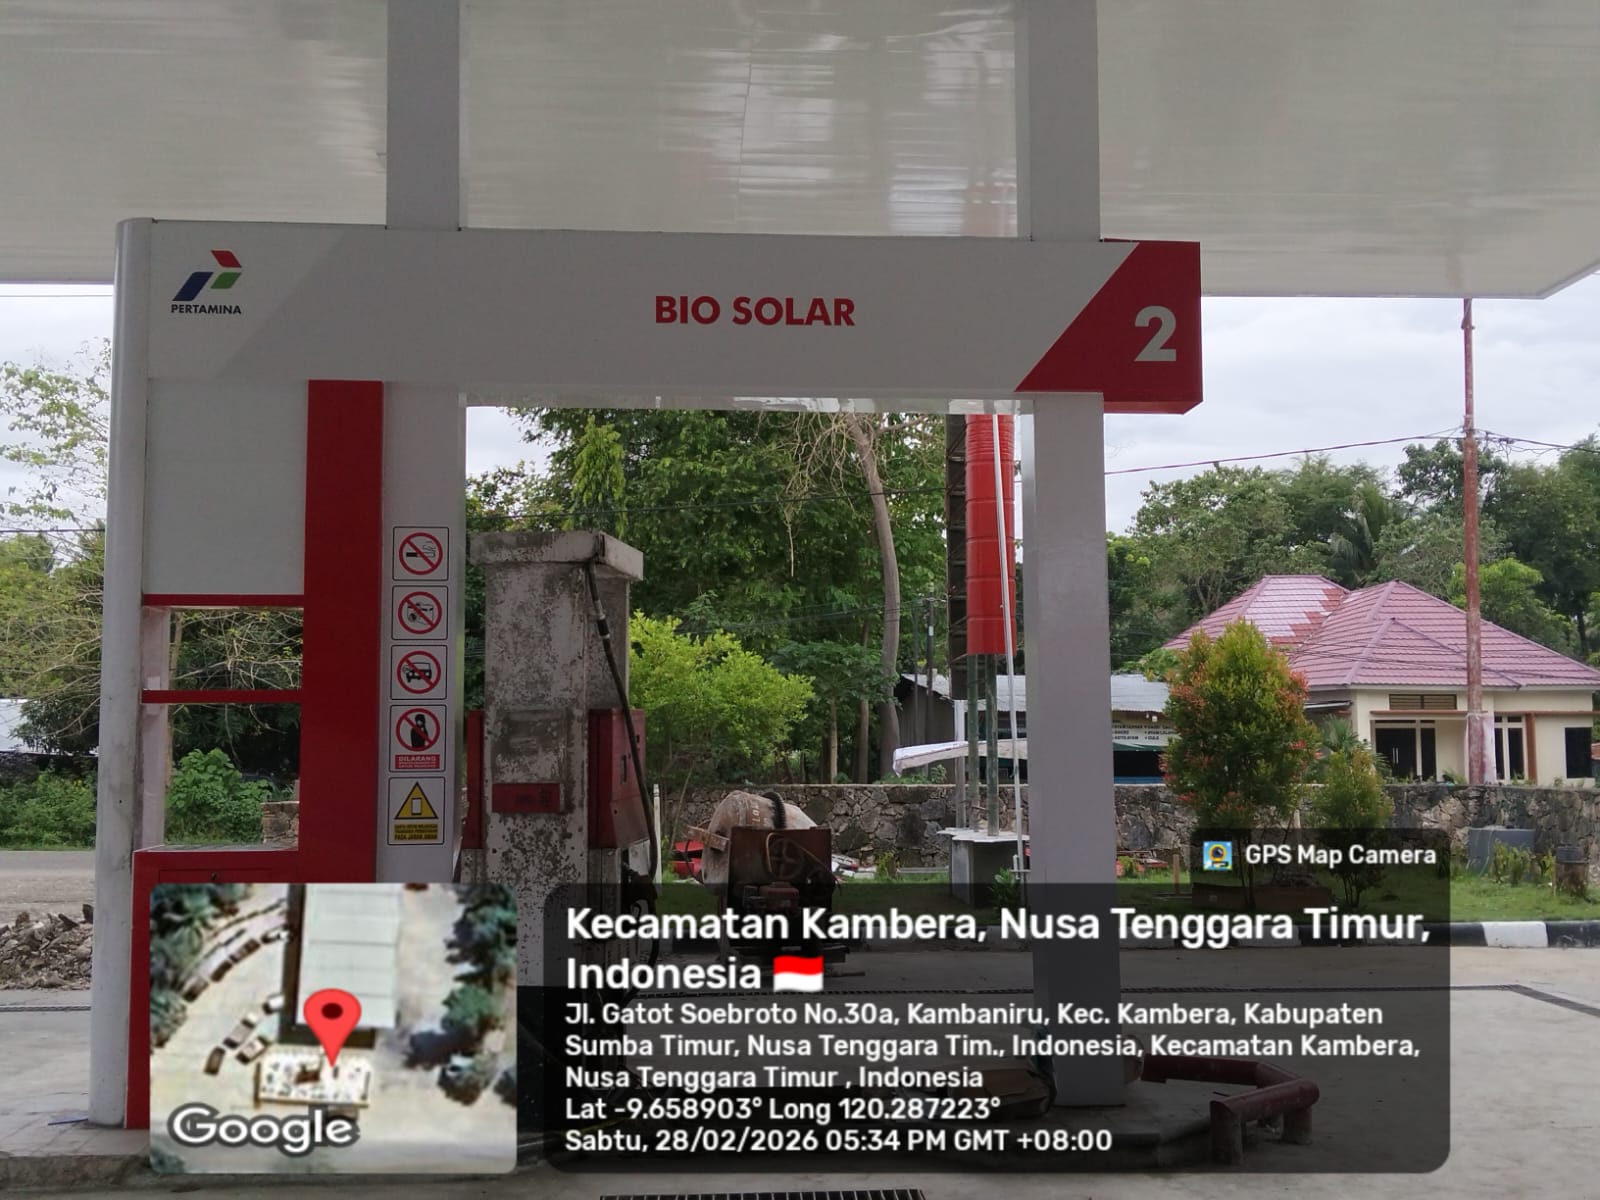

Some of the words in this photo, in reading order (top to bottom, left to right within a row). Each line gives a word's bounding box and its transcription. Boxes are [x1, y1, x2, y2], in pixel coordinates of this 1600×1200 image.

[170, 303, 242, 315] PERTAMINA
[655, 295, 721, 325] BIO
[731, 296, 856, 326] SOLAR
[1133, 305, 1177, 362] 2
